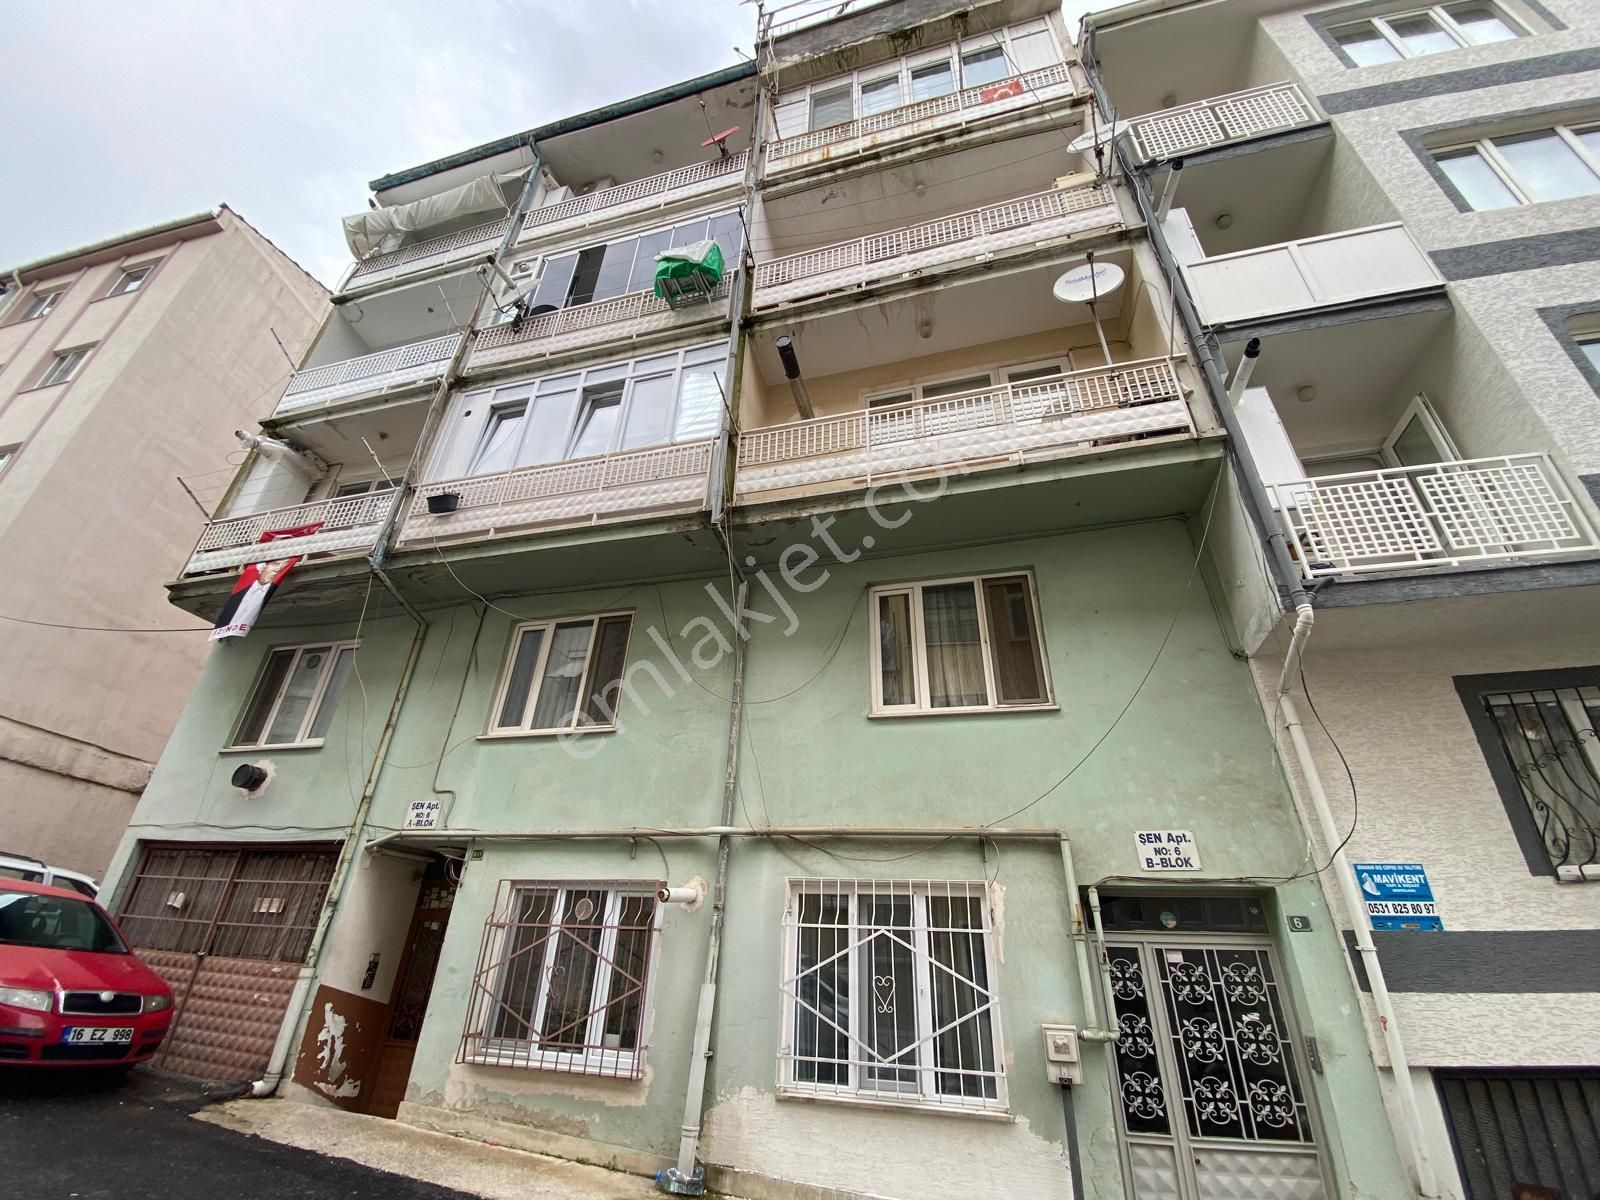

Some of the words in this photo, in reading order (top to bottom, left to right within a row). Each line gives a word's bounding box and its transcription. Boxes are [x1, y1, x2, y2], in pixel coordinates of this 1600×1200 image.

[1166, 832, 1191, 845] Apt.
[1153, 847, 1172, 856] NO:
[1174, 846, 1181, 856] 6
[1145, 857, 1194, 868] B-BLOK
[1373, 873, 1425, 884] MAVİKENT
[1368, 903, 1391, 914] 0531
[1392, 903, 1410, 914] 825
[1410, 903, 1423, 914] 80
[1423, 903, 1435, 914] 97
[1293, 917, 1303, 929] 6
[71, 1028, 85, 1041] 16
[90, 1028, 108, 1041] EZ
[112, 1029, 132, 1041] 998
